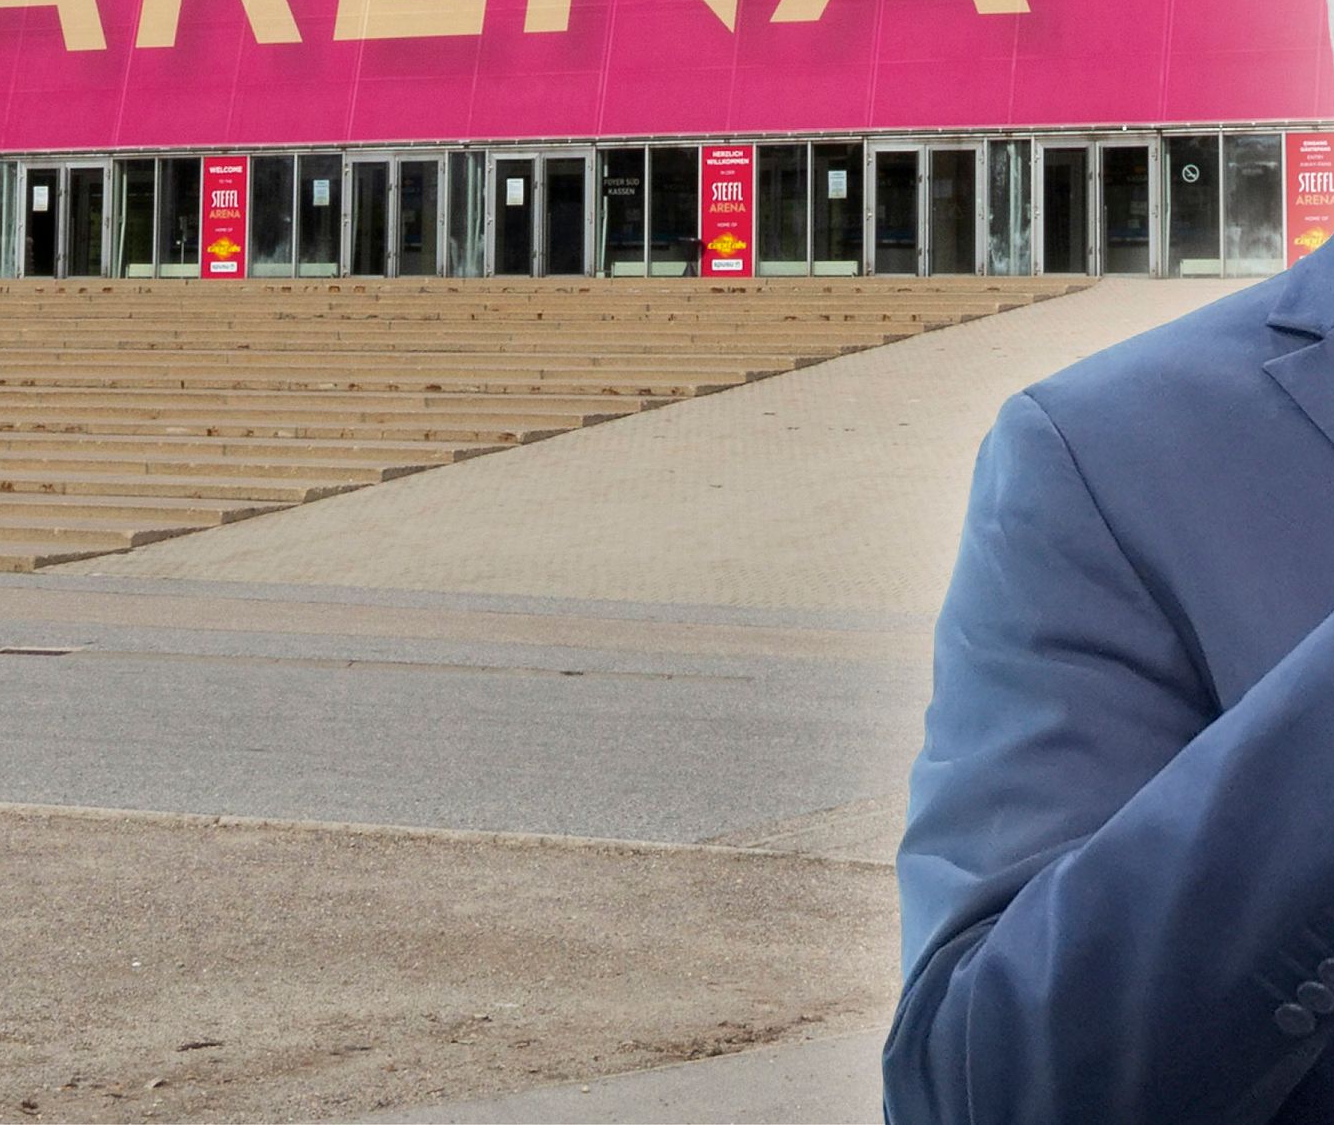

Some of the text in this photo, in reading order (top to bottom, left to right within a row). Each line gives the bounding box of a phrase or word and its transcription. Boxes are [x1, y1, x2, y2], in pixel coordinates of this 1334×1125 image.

[712, 182, 743, 201] STEFFL
[1298, 172, 1334, 193] STEFFL
[212, 190, 238, 208] STEFFL
[710, 203, 746, 213] ARENA
[210, 209, 241, 219] ARENA
